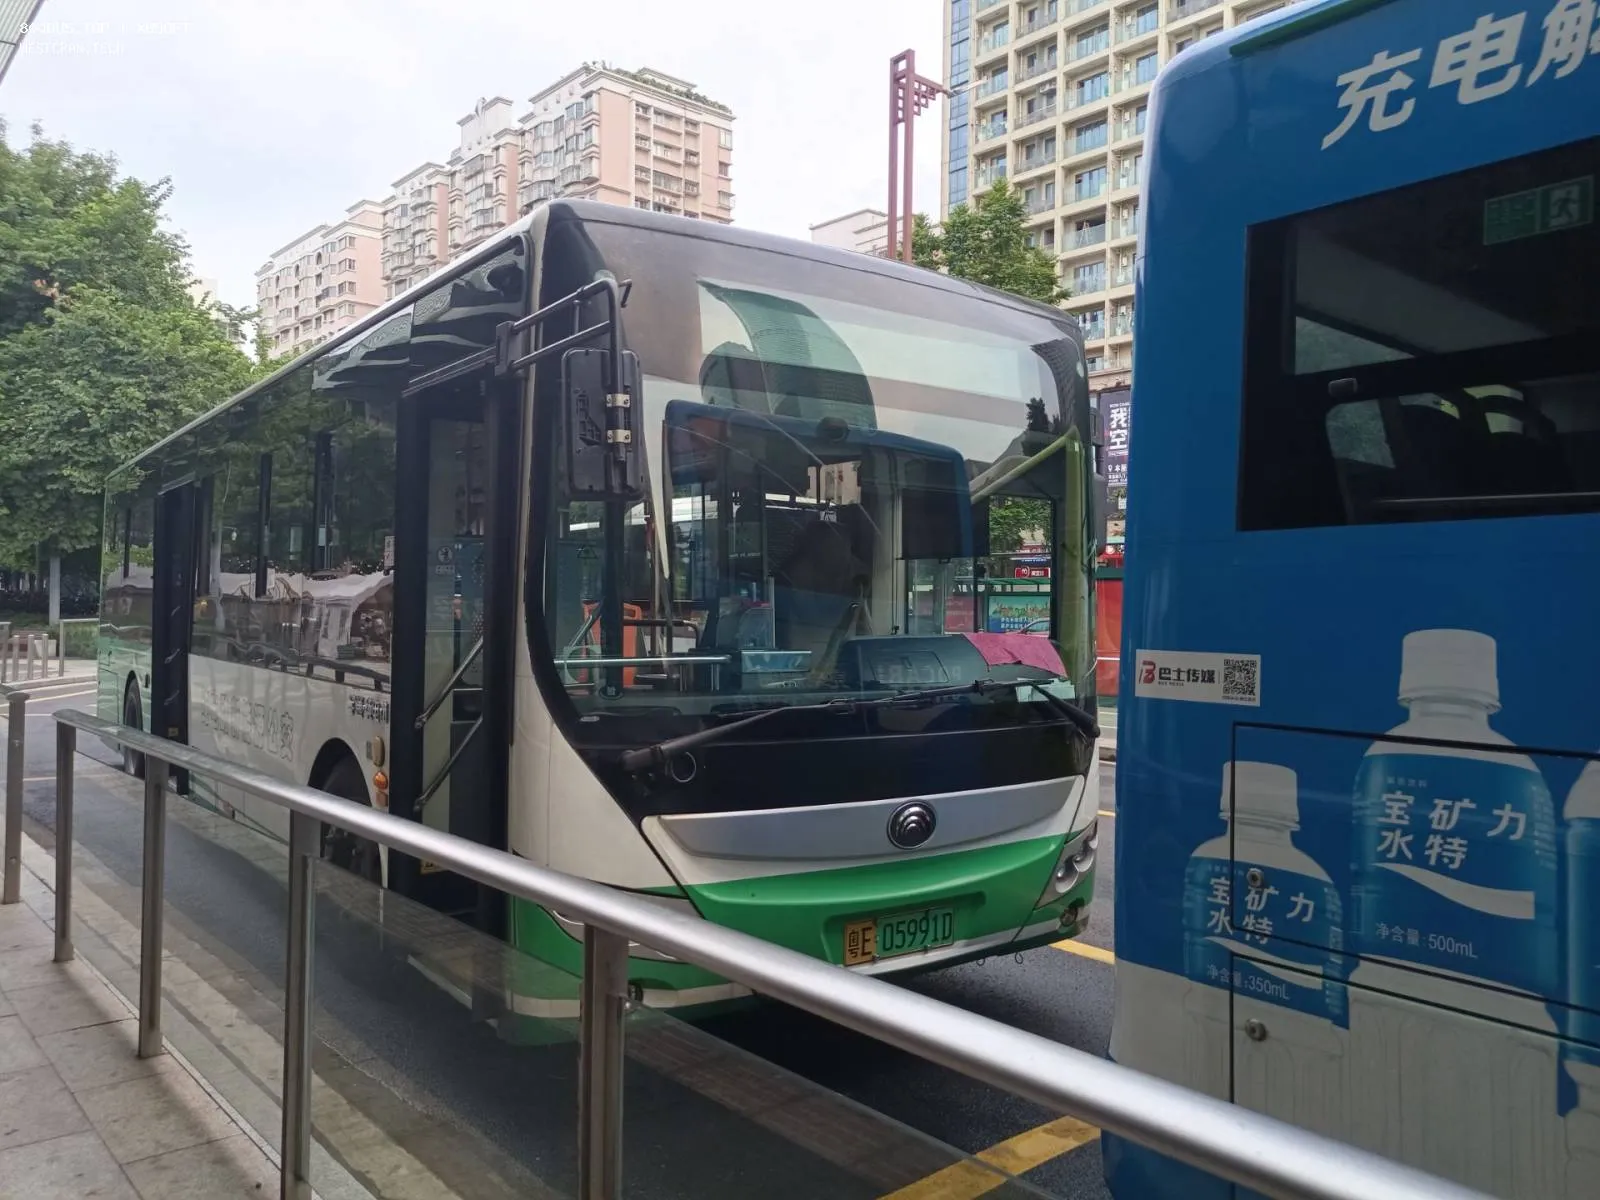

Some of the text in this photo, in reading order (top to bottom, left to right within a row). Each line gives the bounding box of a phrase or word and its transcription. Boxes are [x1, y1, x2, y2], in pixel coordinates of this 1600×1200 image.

[1158, 666, 1216, 685] 巴士传媒
[1377, 790, 1527, 841] 宝矿力
[1376, 829, 1468, 870] 水特
[1206, 875, 1316, 923] 宝矿力
[848, 912, 953, 959] 粤E 05991D
[1206, 908, 1274, 945] 水特
